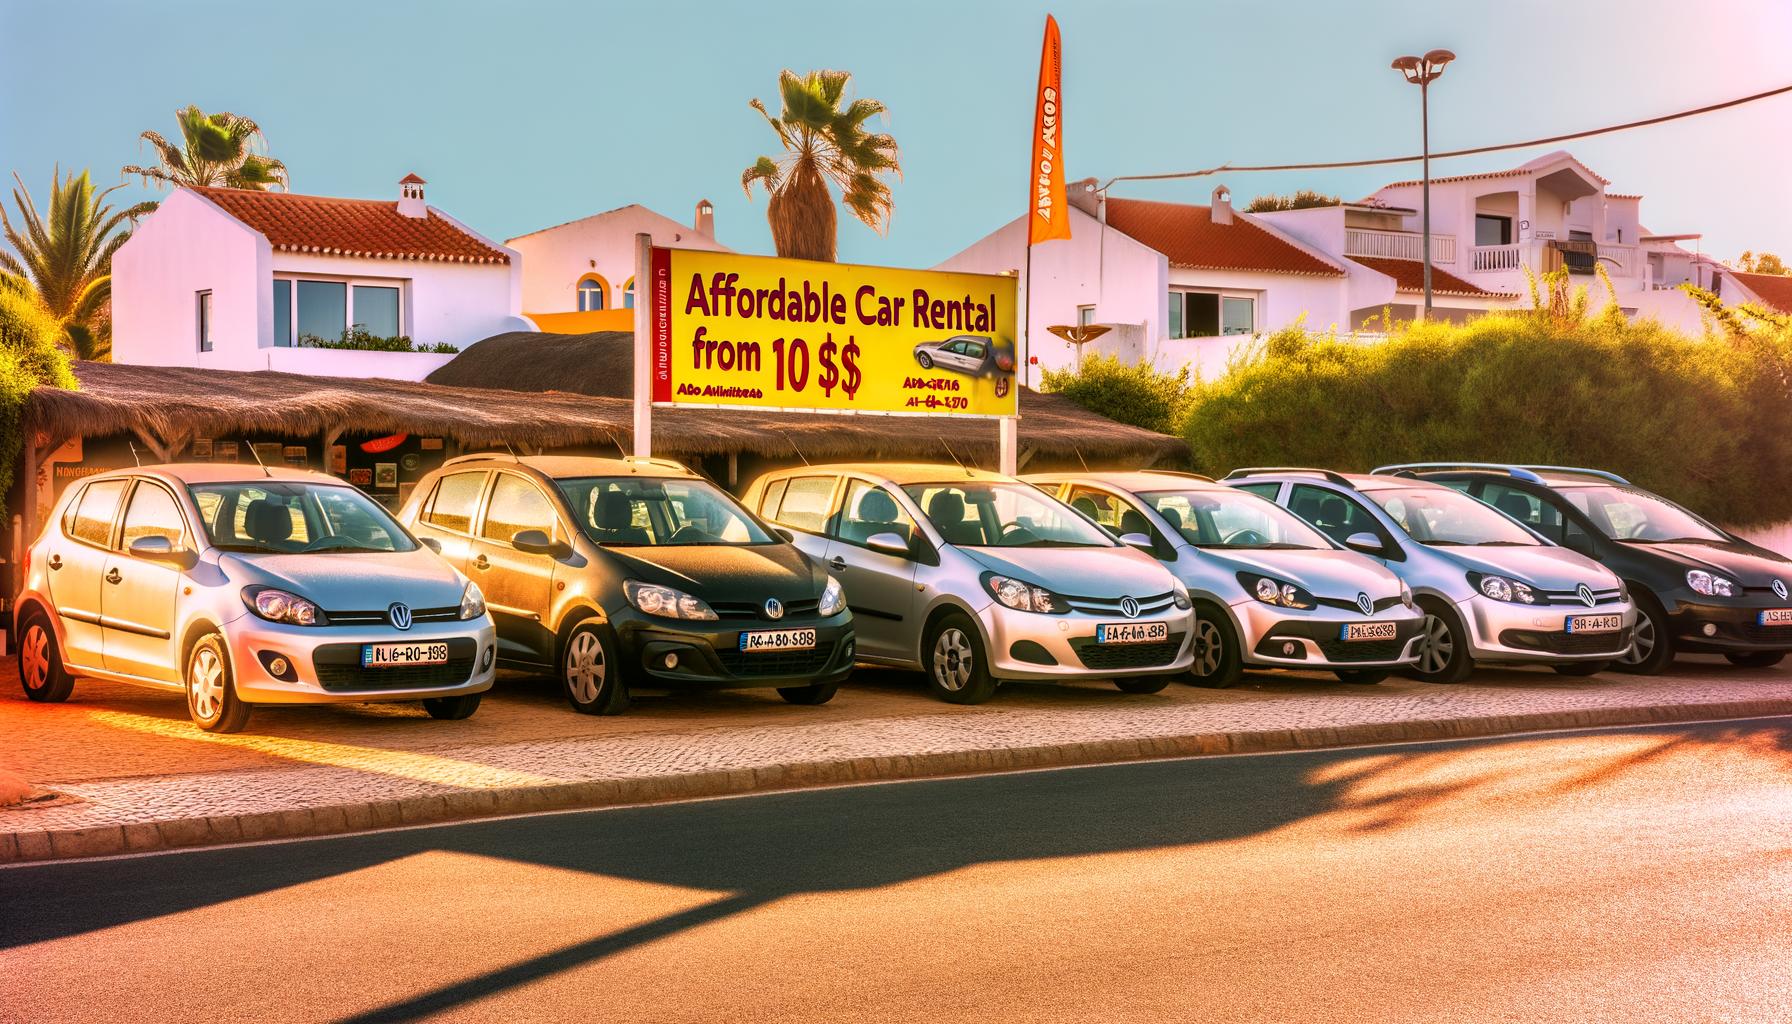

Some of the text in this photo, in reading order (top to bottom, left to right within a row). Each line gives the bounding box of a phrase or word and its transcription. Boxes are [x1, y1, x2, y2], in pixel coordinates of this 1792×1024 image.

[684, 271, 997, 332] Affordable Car Rental
[692, 326, 862, 401] from 10 $$
